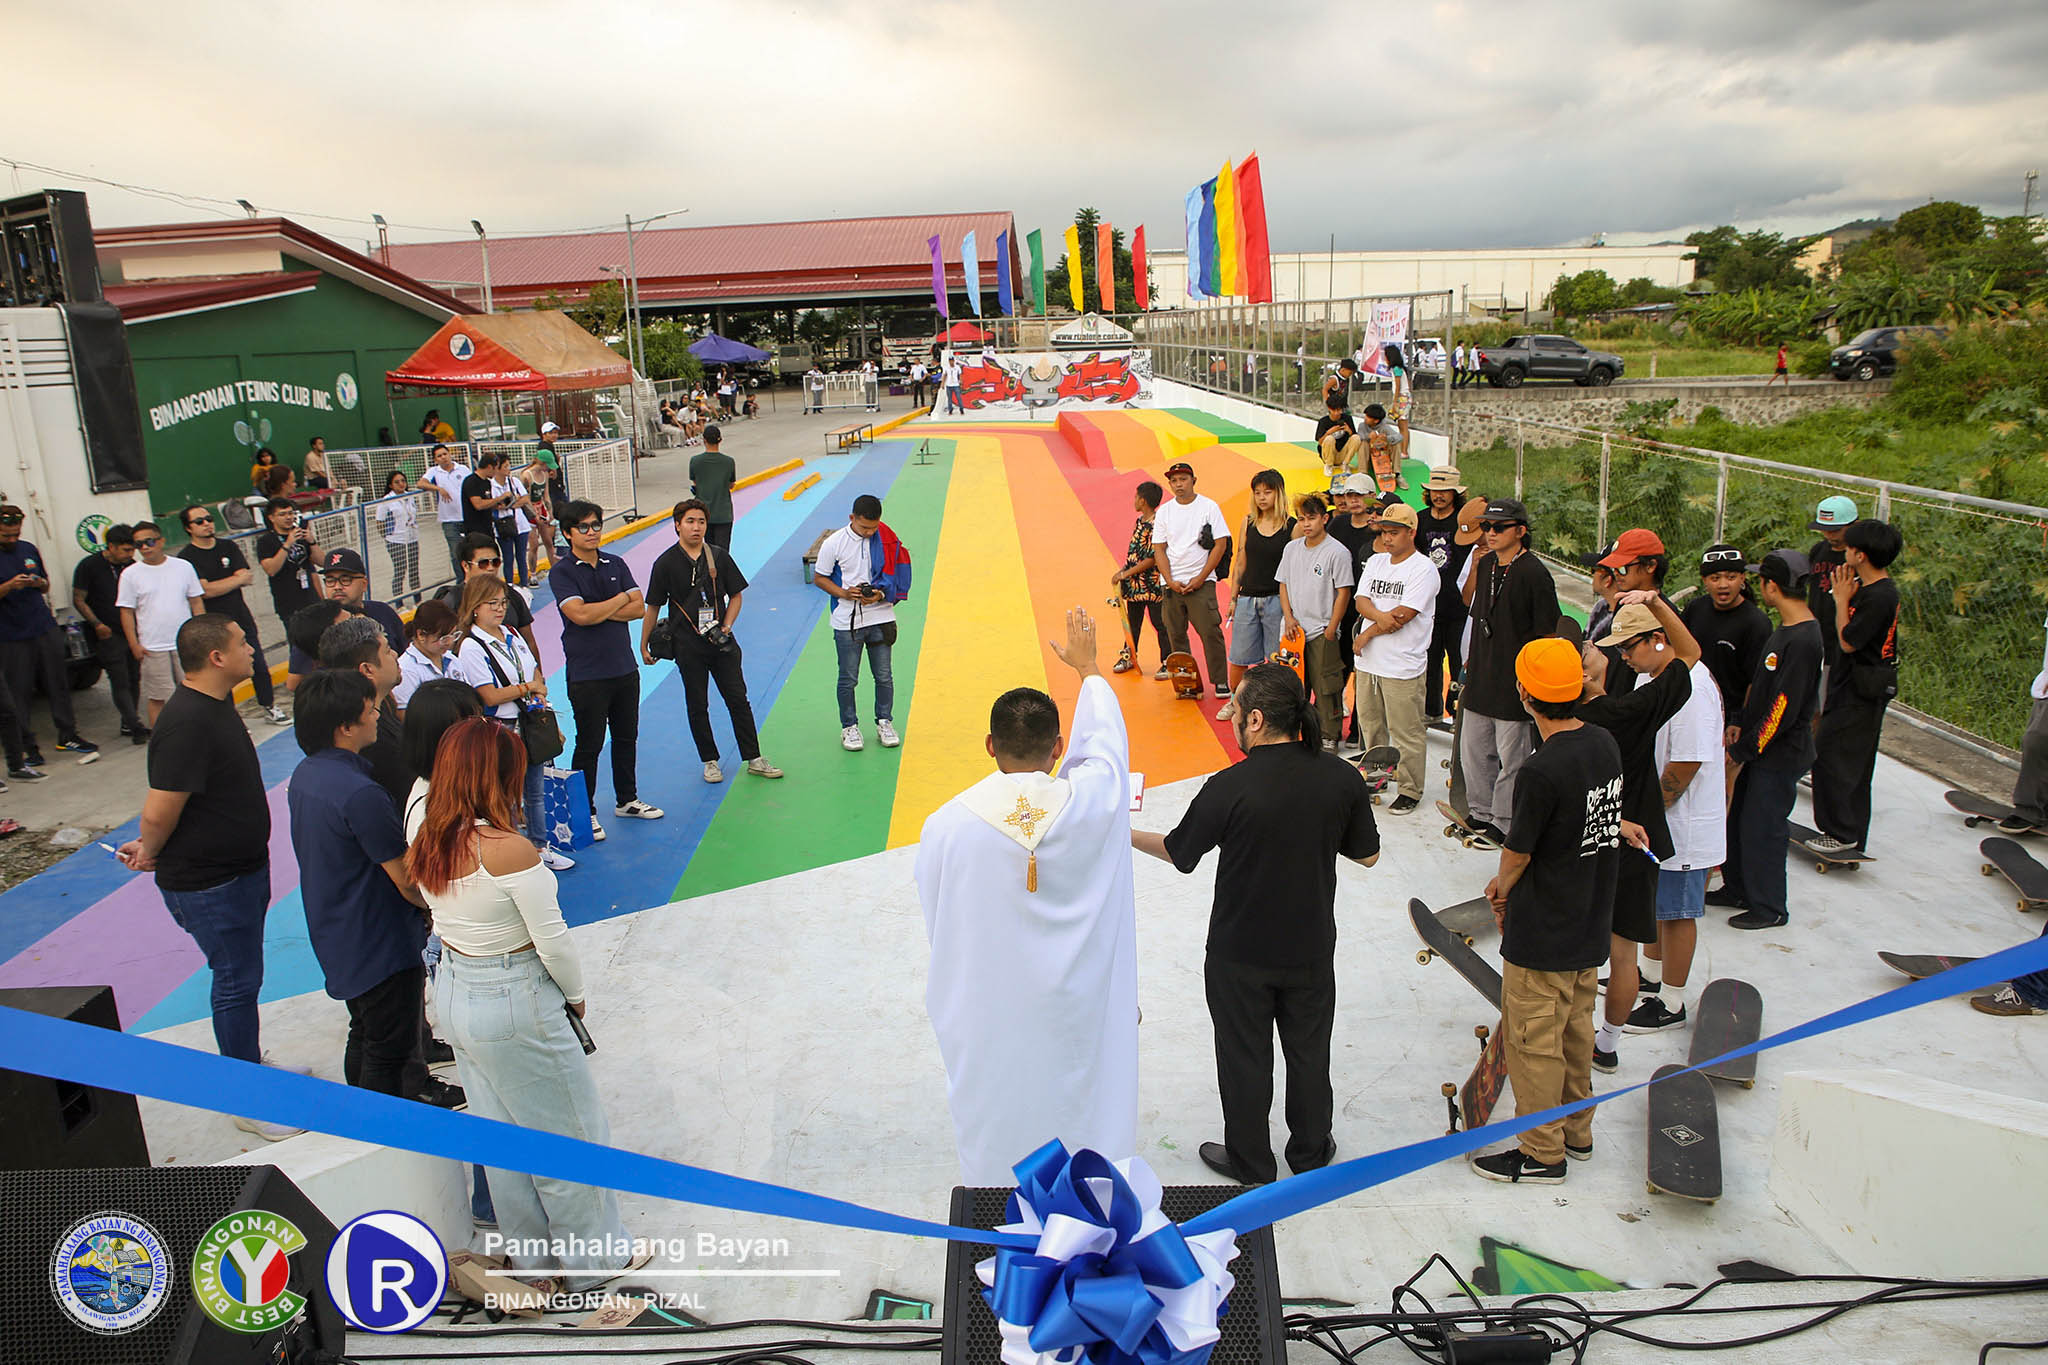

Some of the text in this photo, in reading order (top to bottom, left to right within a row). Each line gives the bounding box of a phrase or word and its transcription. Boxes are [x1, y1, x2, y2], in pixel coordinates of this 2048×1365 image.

[149, 380, 334, 431] BINANGONAN TENNIS CLUB INC.
